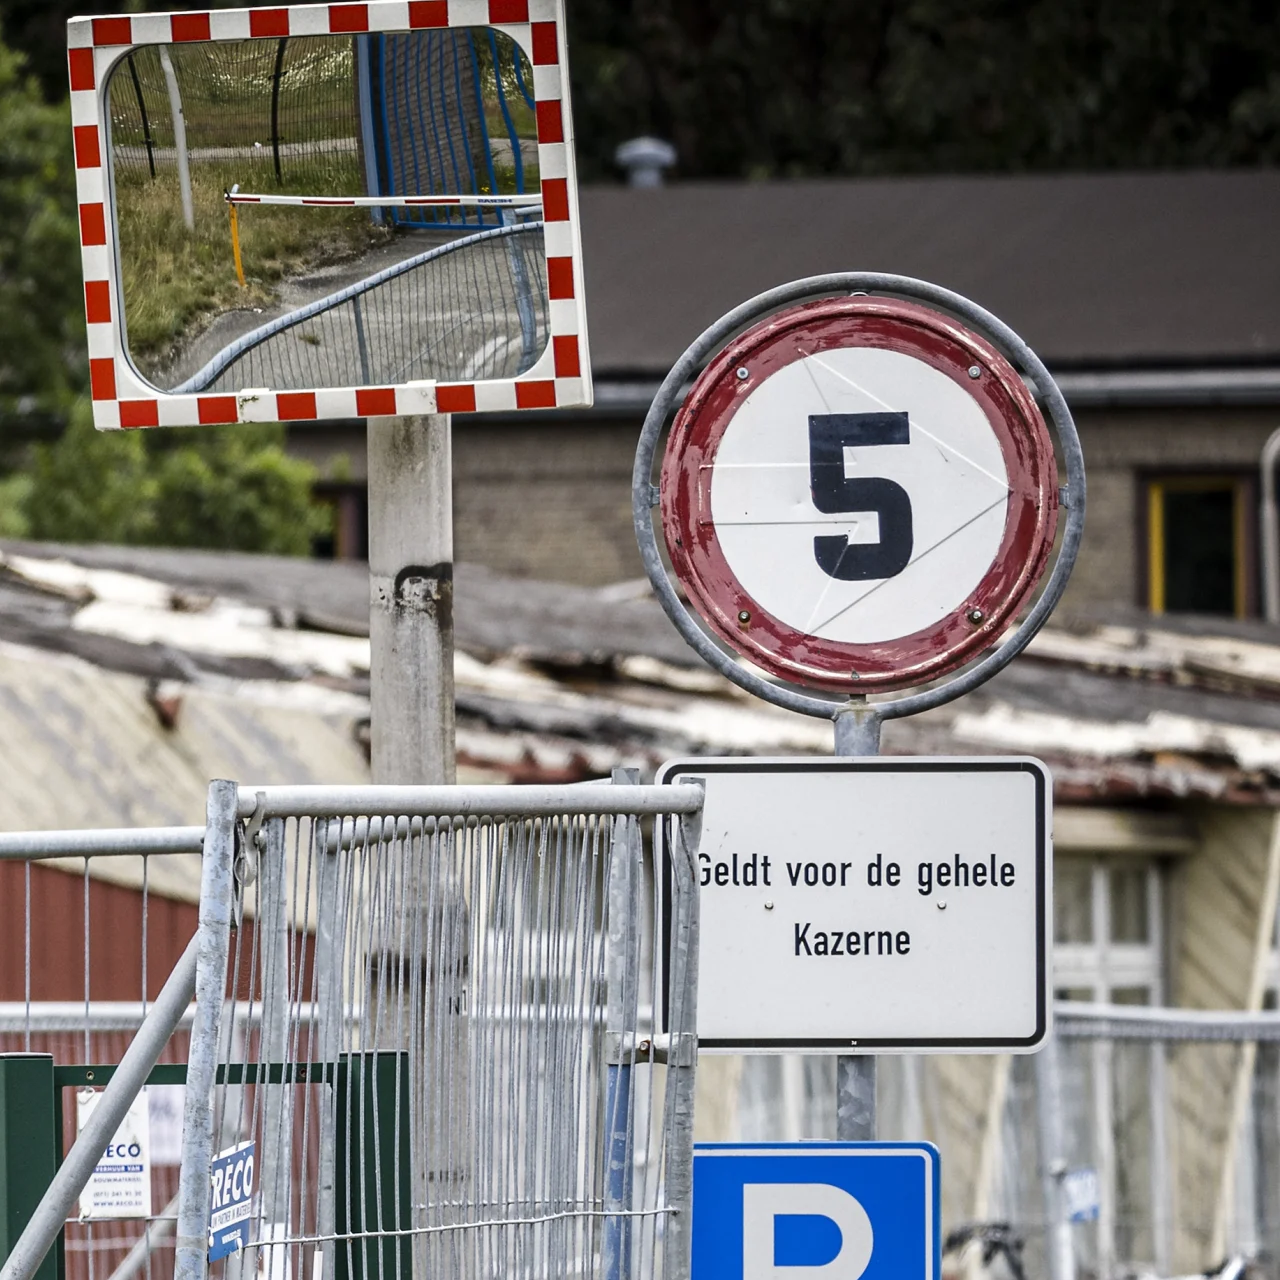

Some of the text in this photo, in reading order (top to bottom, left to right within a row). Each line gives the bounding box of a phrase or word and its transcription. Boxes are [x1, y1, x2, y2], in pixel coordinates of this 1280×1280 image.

[808, 411, 913, 581] 5
[698, 853, 1016, 896] Geldt voor de gehele
[794, 922, 912, 957] Kazerne
[100, 1143, 141, 1158] ECO
